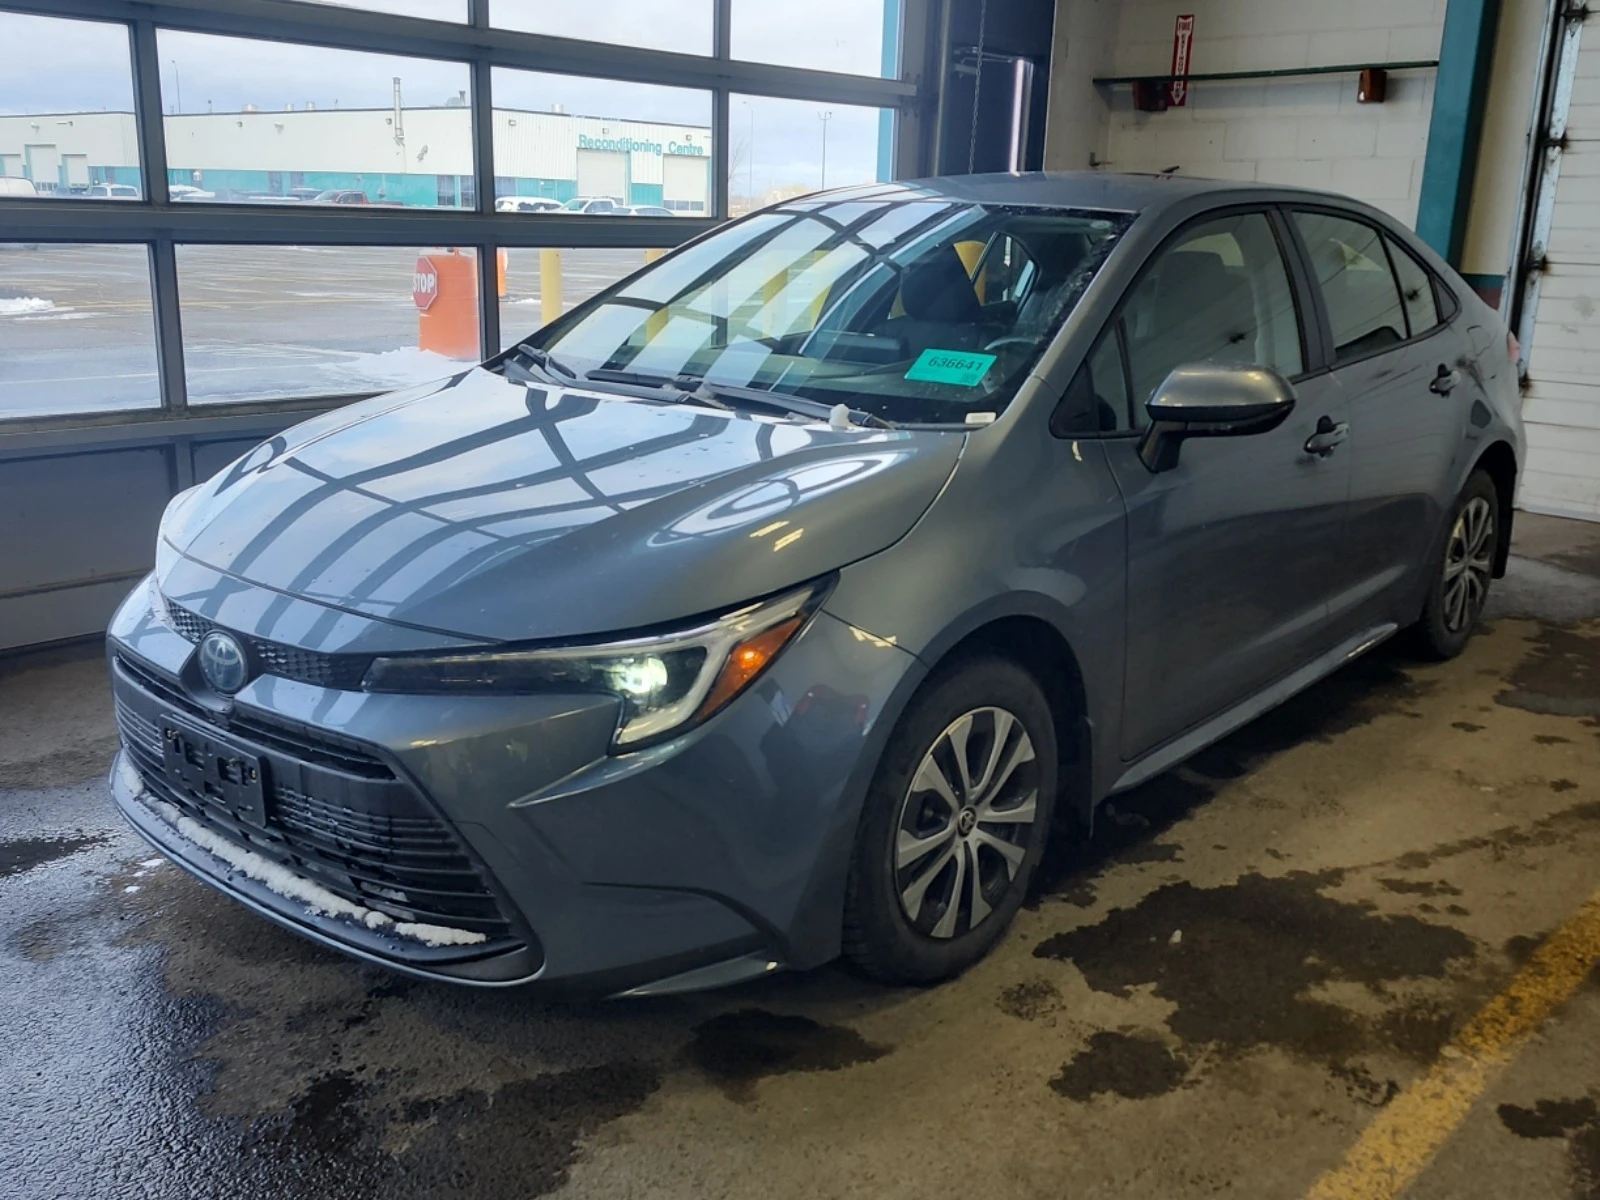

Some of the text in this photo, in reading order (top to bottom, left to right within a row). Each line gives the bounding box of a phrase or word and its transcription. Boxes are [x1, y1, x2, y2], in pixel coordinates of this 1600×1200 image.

[578, 134, 704, 156] Reconditioning Centre
[412, 272, 435, 293] STOP
[928, 356, 983, 371] 636641
